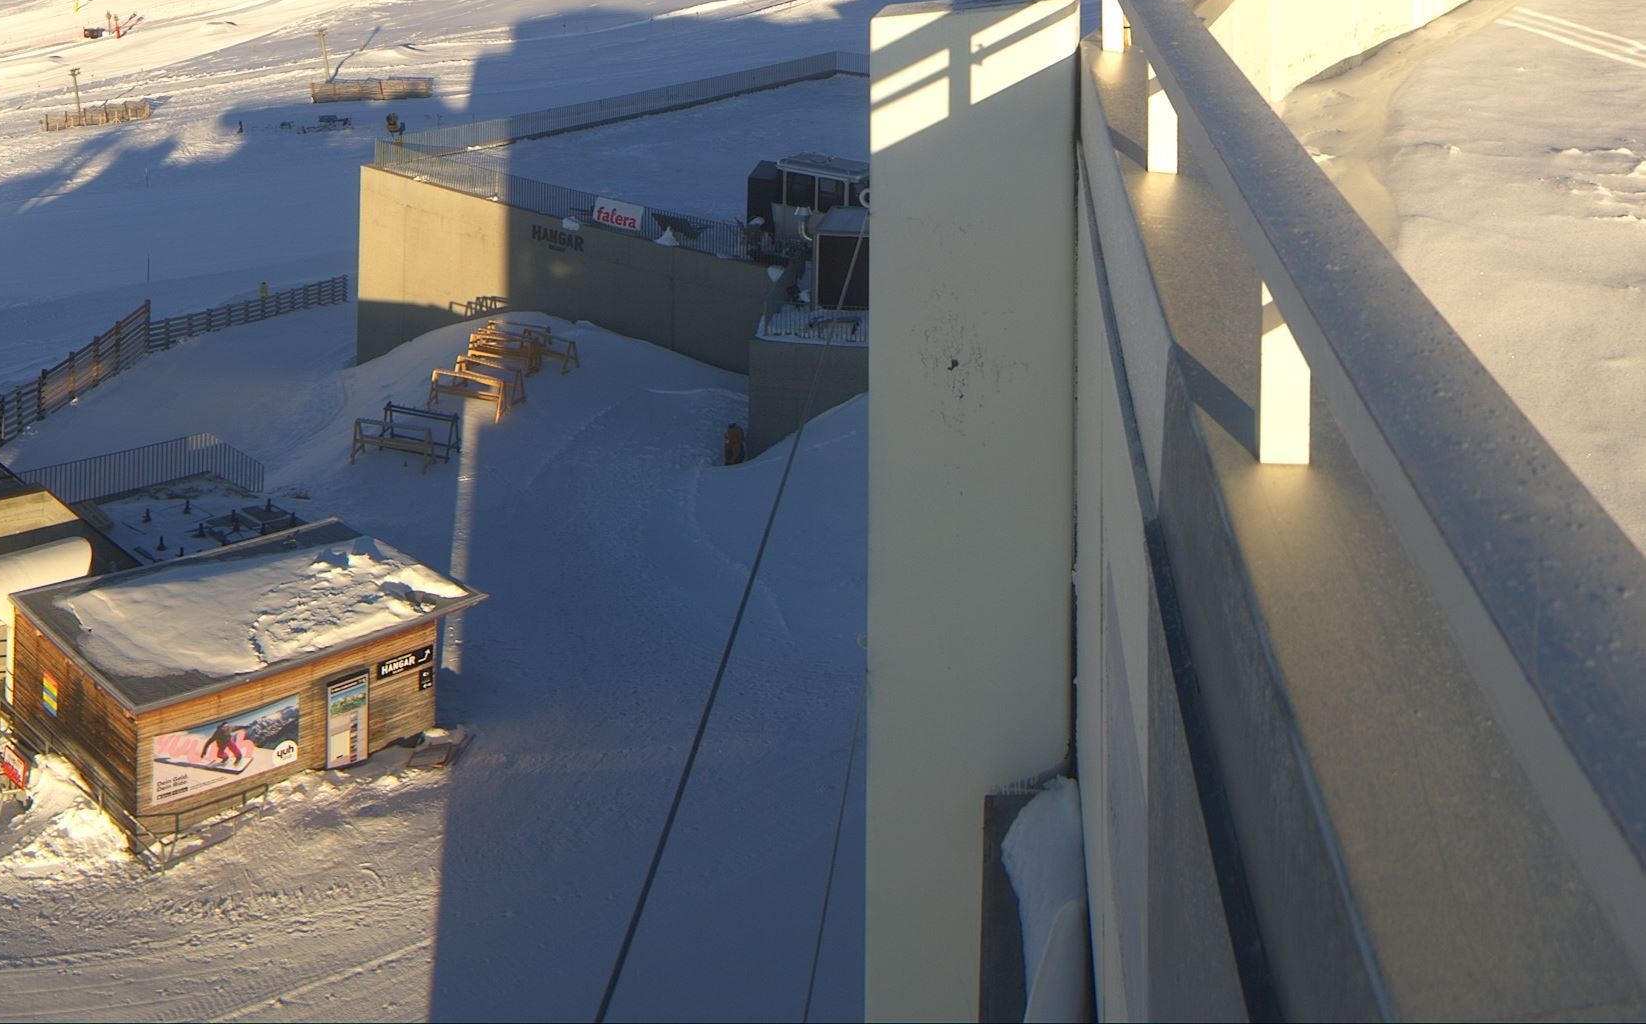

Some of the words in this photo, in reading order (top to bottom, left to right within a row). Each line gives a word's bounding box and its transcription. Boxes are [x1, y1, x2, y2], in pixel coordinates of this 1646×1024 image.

[596, 206, 637, 230] falera
[531, 223, 584, 252] HANGAR
[381, 655, 416, 676] HANGAR
[276, 744, 294, 759] yuh
